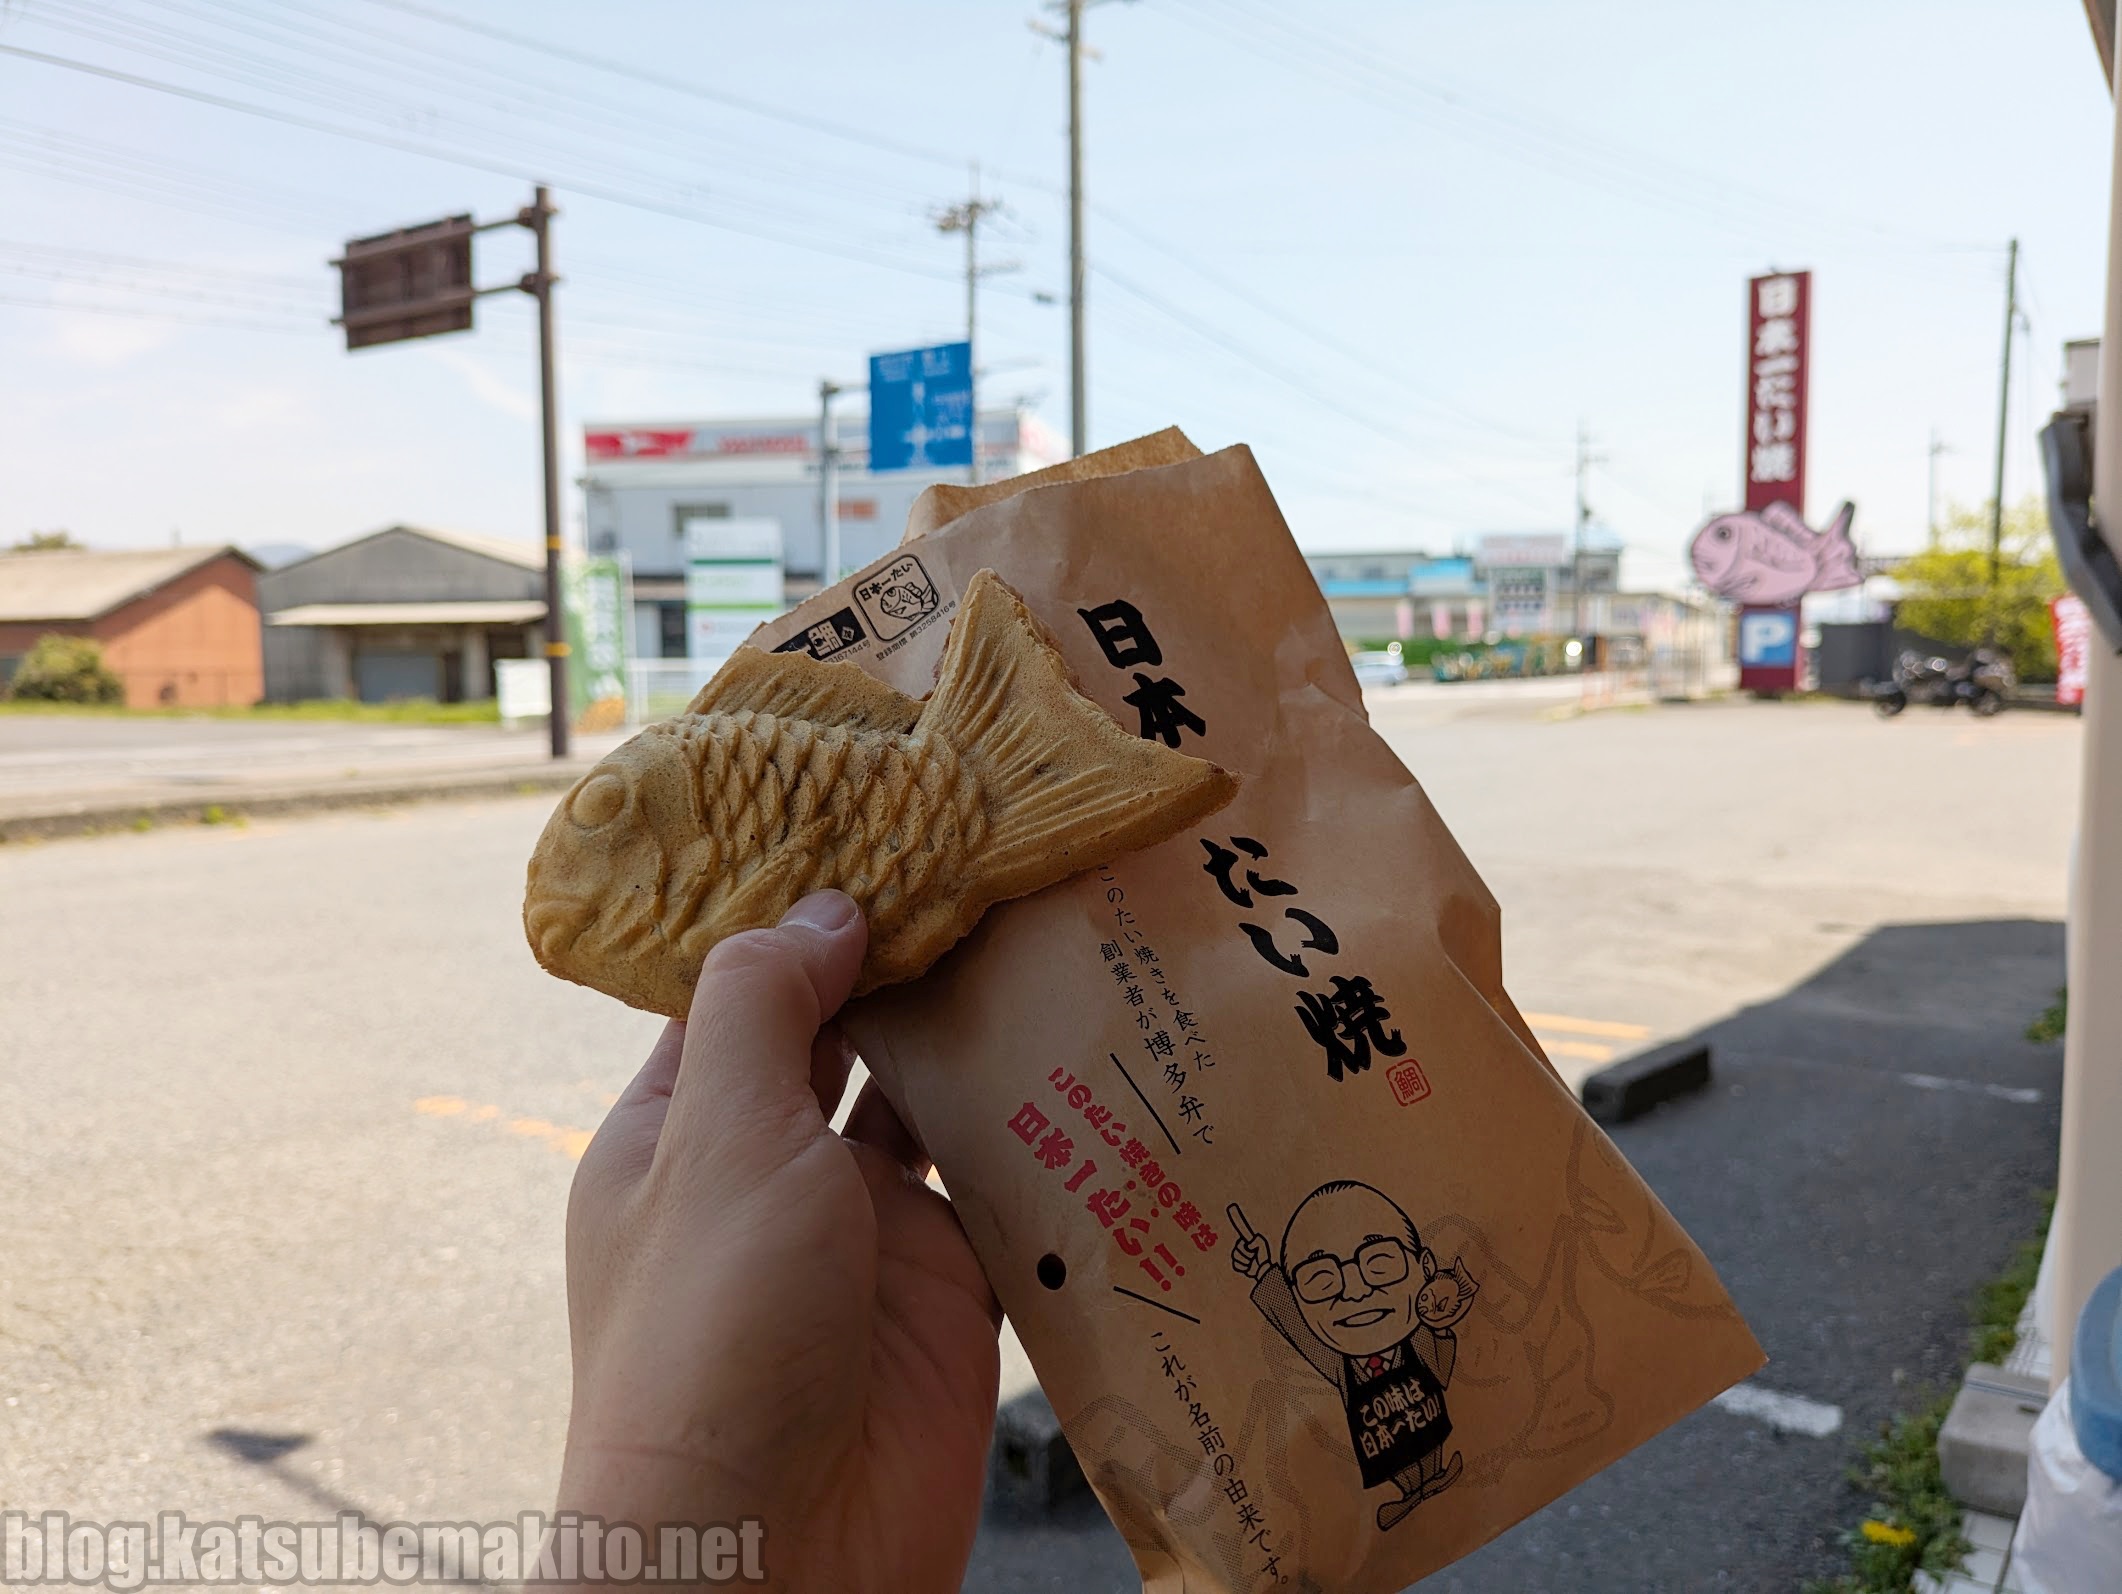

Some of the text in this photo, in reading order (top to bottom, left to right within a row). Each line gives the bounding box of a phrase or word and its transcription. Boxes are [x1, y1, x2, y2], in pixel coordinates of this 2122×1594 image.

[858, 562, 913, 602] 日本一たい
[1743, 616, 1788, 663] P
[1077, 600, 1407, 1083] 日本たい焼
[1098, 865, 1216, 1071] このたい焼きを食べた
[1100, 939, 1215, 1144] 創業者が博多弁で
[1048, 1067, 1218, 1251] このたい焼きの味は
[1151, 1331, 1288, 1585] これが名前の由来です。
[1360, 1377, 1425, 1428] この味は
